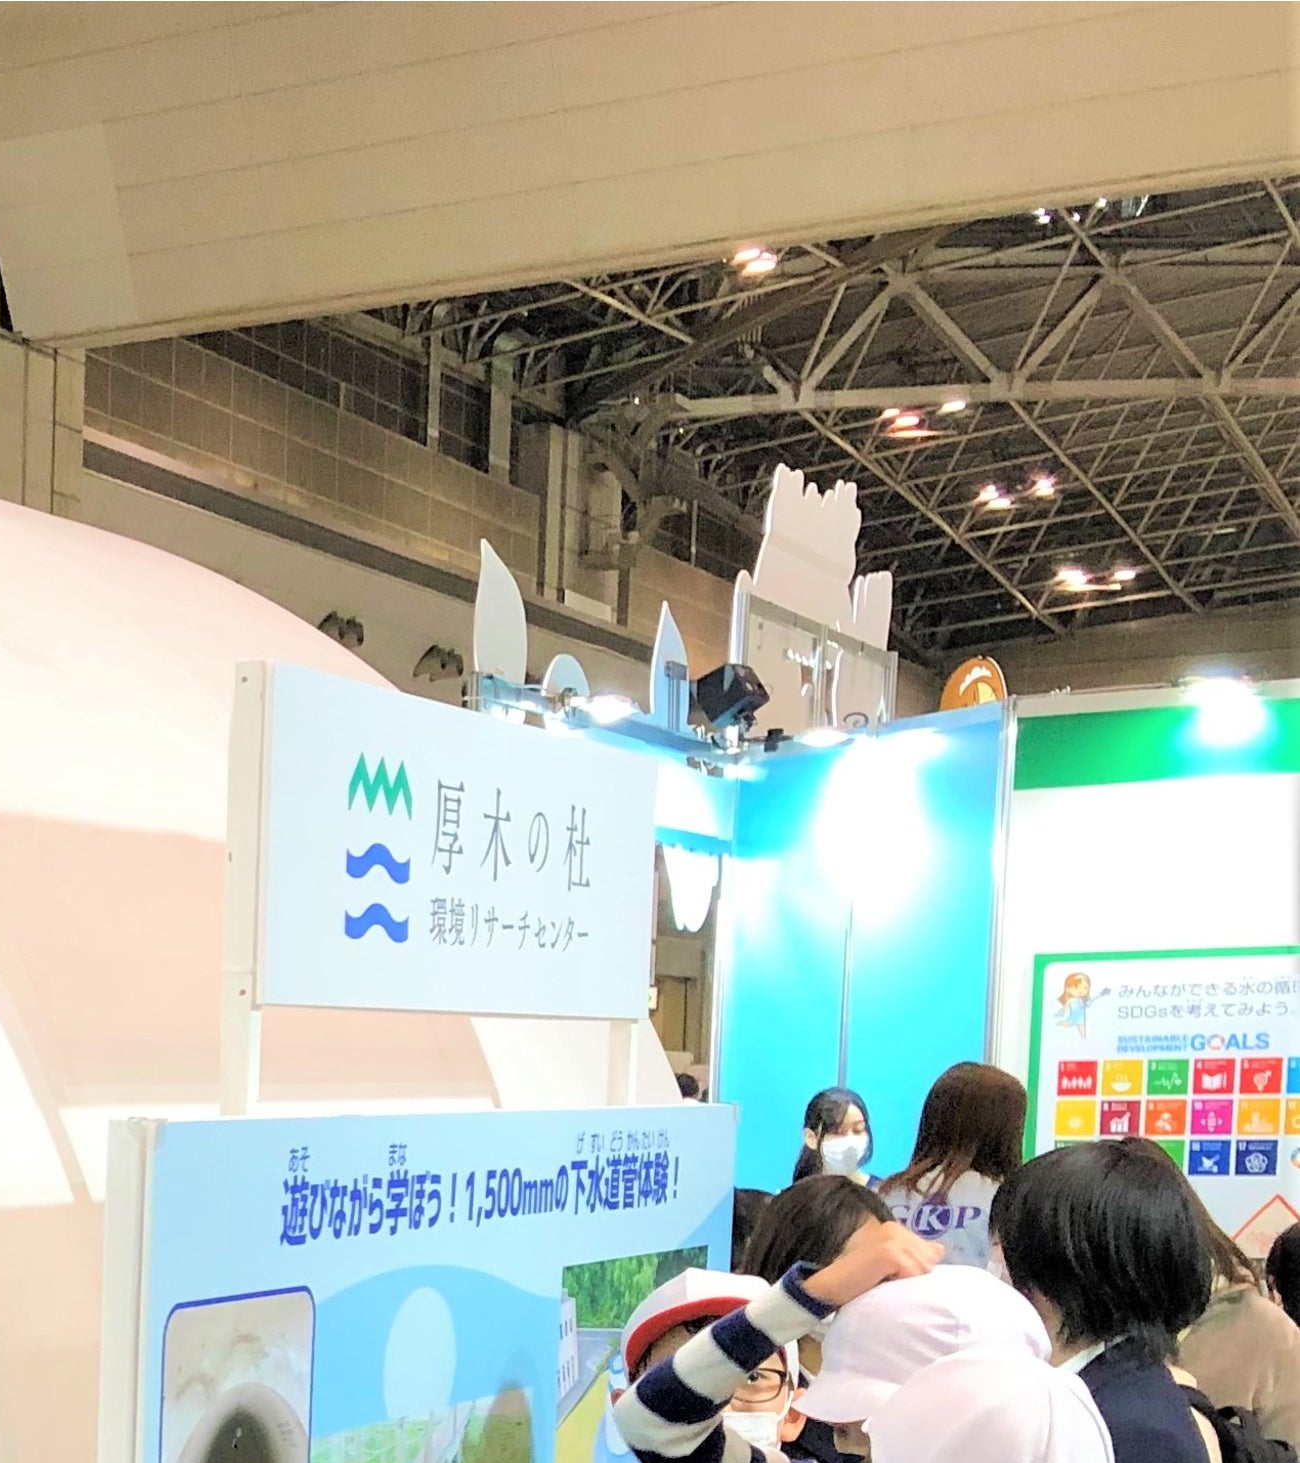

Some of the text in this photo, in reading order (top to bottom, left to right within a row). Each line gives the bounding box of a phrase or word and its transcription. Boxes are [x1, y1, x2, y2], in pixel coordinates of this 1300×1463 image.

[430, 777, 592, 893] 厚木の杜
[428, 896, 590, 953] 環境リサーチセンター
[287, 1145, 311, 1173] あそ
